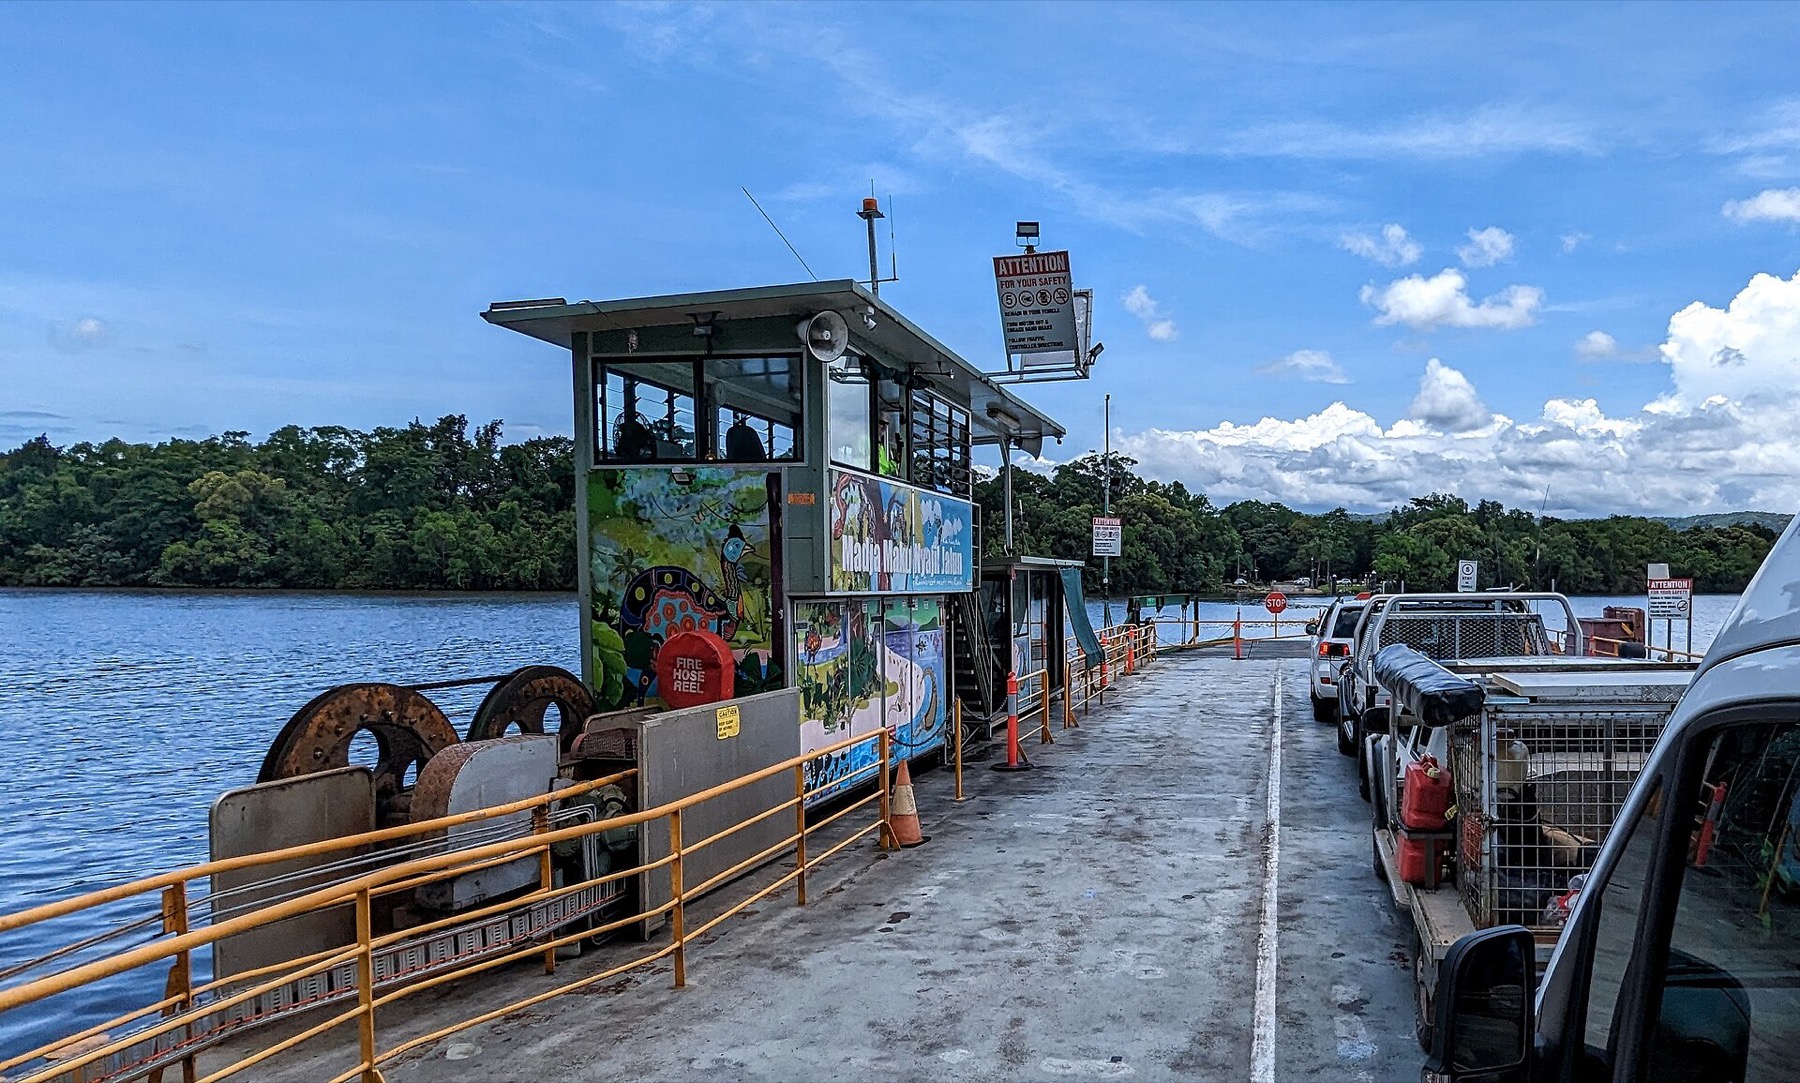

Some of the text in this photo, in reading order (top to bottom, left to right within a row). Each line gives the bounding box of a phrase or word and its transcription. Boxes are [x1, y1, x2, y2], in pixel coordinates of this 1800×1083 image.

[999, 255, 1066, 275] ATTENTION
[1001, 276, 1067, 289] FOR YOUR SAFETY
[1005, 295, 1012, 305] 5
[1651, 581, 1687, 589] ATTENTION
[1266, 599, 1286, 607] STOP
[676, 657, 703, 670] FIRE
[672, 668, 705, 682] HOSE
[673, 680, 704, 694] REEL
[719, 709, 737, 718] CAUTION
